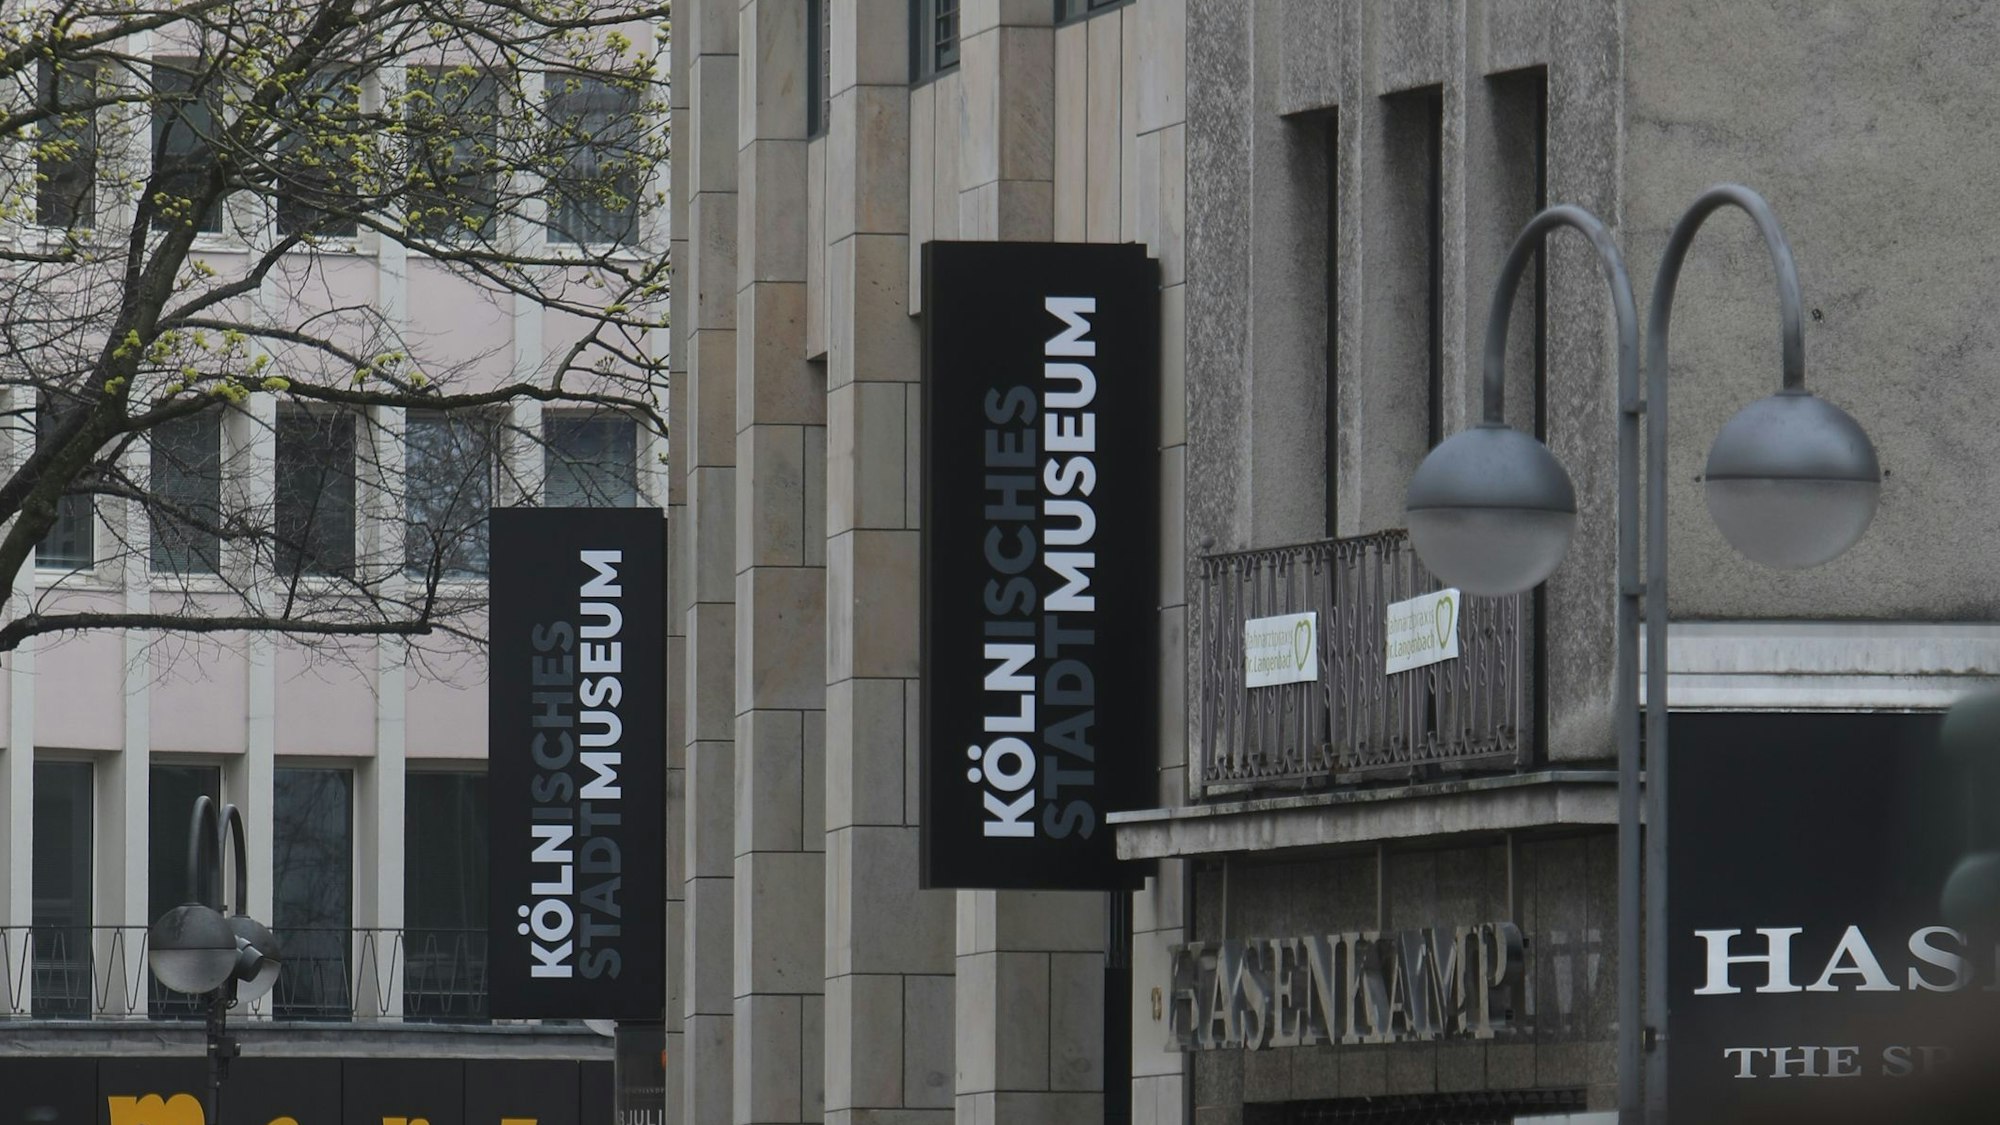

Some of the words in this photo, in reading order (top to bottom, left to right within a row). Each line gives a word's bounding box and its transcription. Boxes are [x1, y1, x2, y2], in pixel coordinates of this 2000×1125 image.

[579, 549, 623, 980] STADTMUSEUM
[967, 384, 1037, 838] KÖLNISCHES
[1043, 296, 1097, 840] STADTMUSEUM
[517, 620, 574, 978] KÖLNISCHES
[1724, 1046, 1862, 1078] THE
